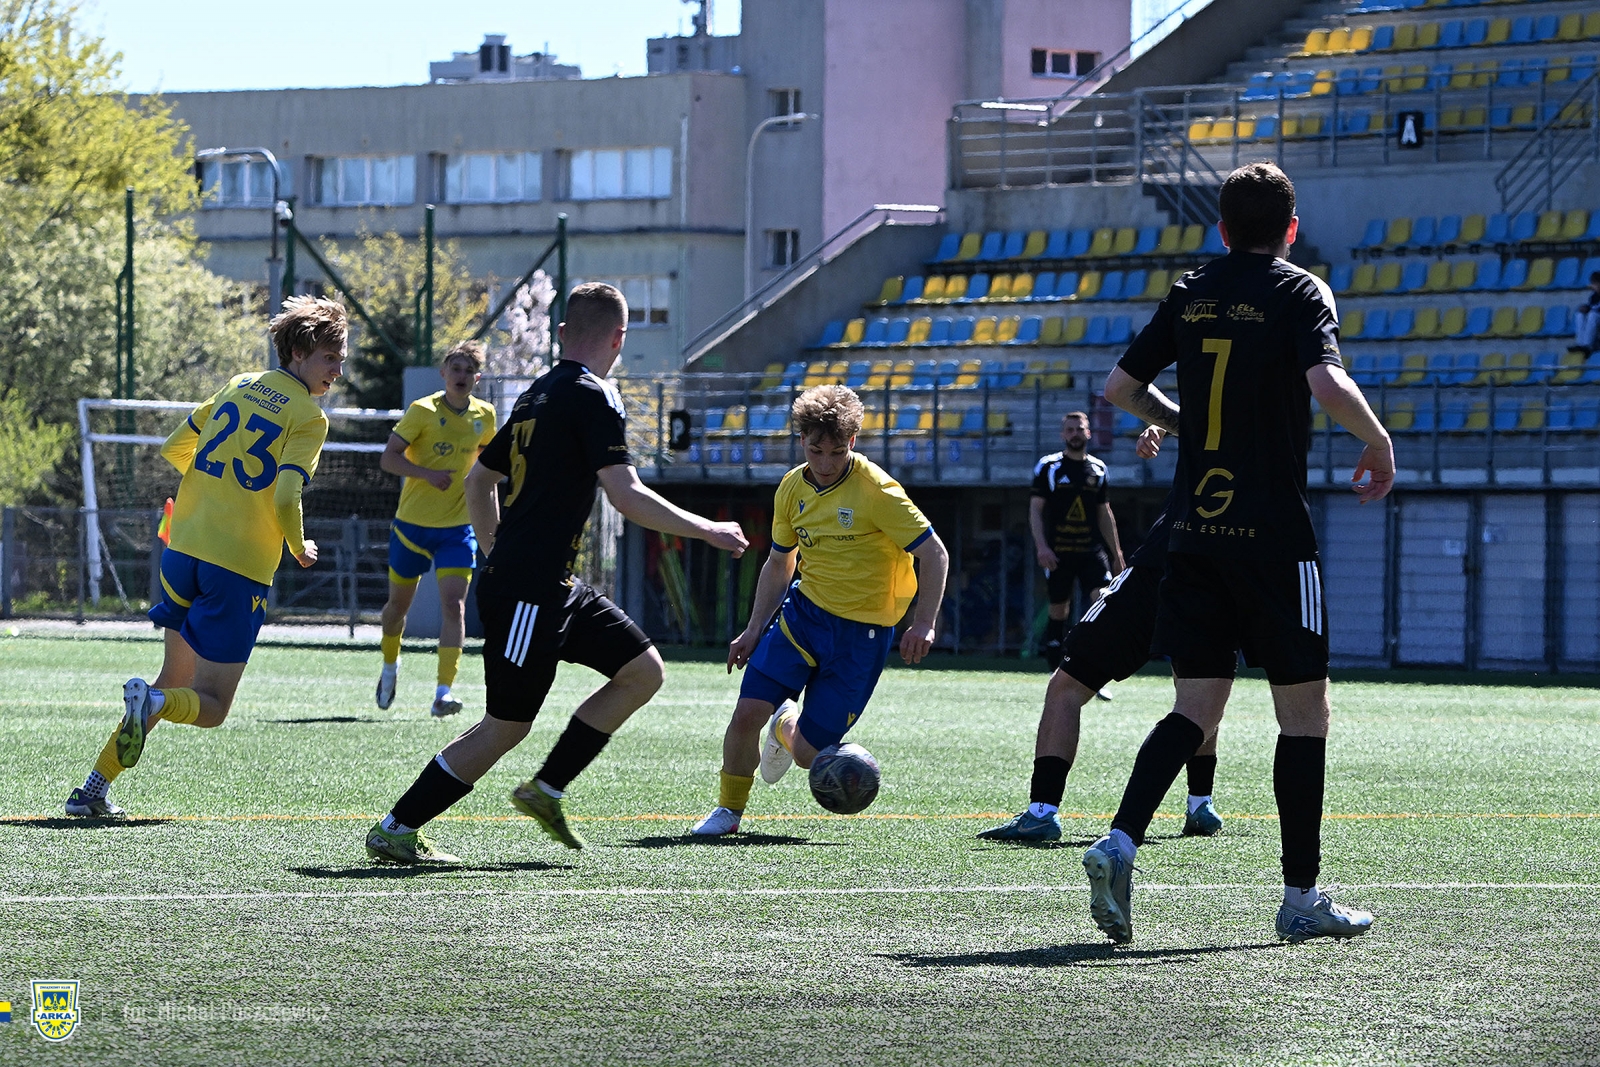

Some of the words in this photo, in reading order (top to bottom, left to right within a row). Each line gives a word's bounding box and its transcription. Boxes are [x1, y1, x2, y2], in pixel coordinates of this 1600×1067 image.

[243, 393, 261, 405] GRUPA
[250, 380, 290, 405] Energa
[1202, 338, 1232, 450] 7
[195, 401, 283, 492] 23
[1199, 524, 1257, 538] ESTATE
